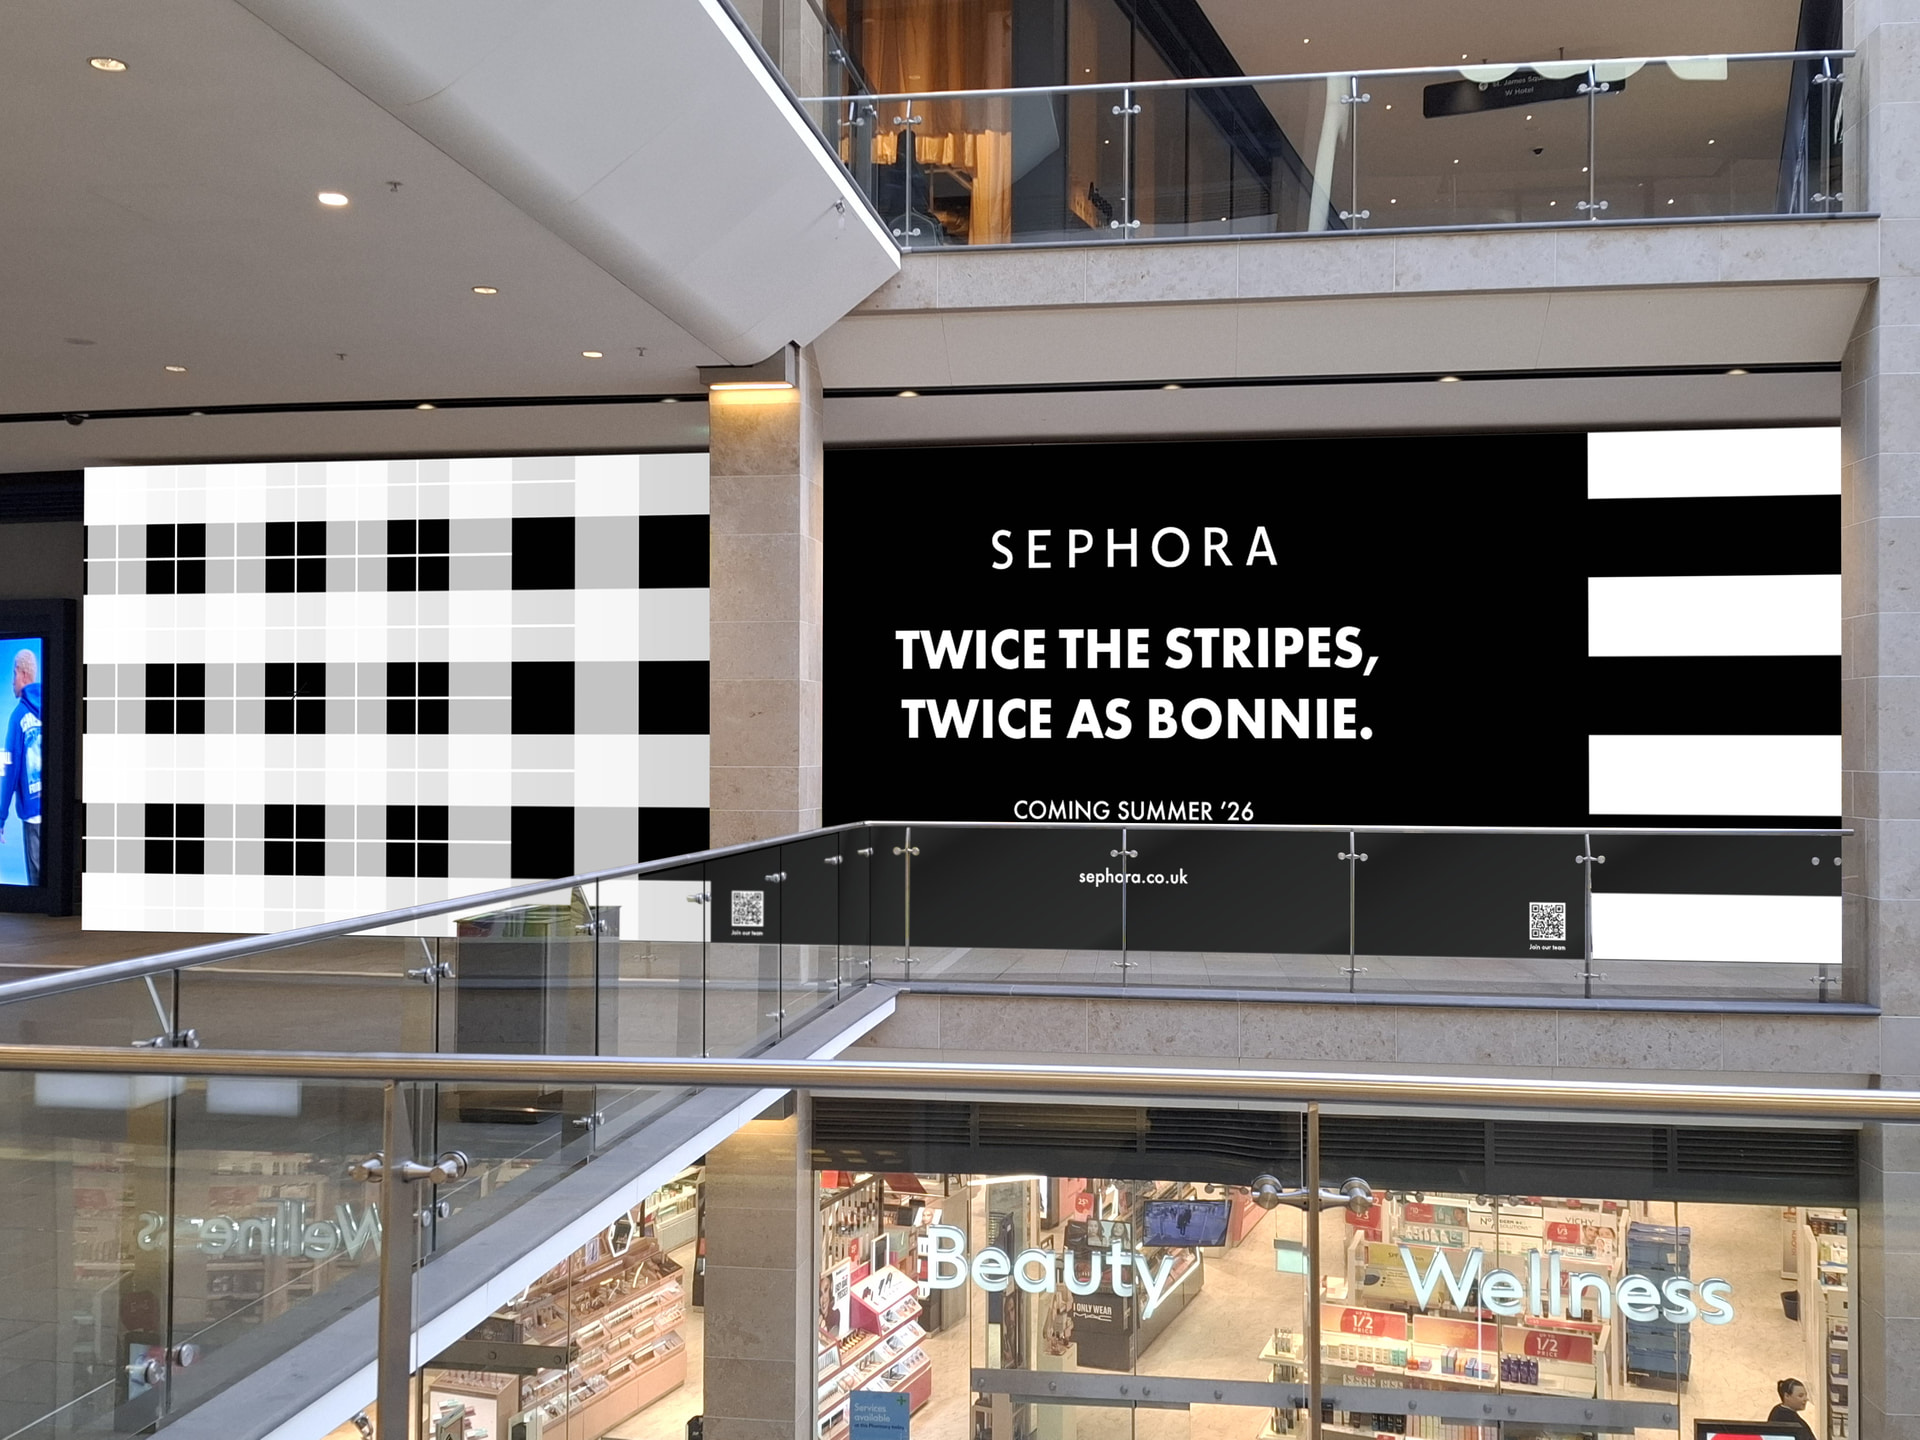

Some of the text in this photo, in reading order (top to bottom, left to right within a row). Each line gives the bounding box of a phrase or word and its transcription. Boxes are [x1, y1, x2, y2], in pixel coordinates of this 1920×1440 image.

[1504, 78, 1526, 86] James
[1515, 86, 1534, 95] Hotel
[991, 525, 1278, 570] SEPHORA
[895, 626, 1379, 677] TWICE THE STRIPES,
[901, 698, 1373, 740] TWICE AS BONNIE.
[1013, 800, 1111, 821] COMING
[1117, 801, 1213, 821] SUMMER
[1079, 867, 1188, 888] sephora.co.uk
[1565, 1216, 1595, 1226] VICHY
[928, 1224, 1175, 1320] Beauty
[1396, 1245, 1735, 1326] Wellness
[1077, 1303, 1092, 1312] ONLY
[1093, 1305, 1112, 1315] WEAR
[1352, 1314, 1374, 1329] 1/2
[1536, 1337, 1558, 1352] 1/2
[854, 1402, 887, 1412] Services
[854, 1412, 891, 1422] available
